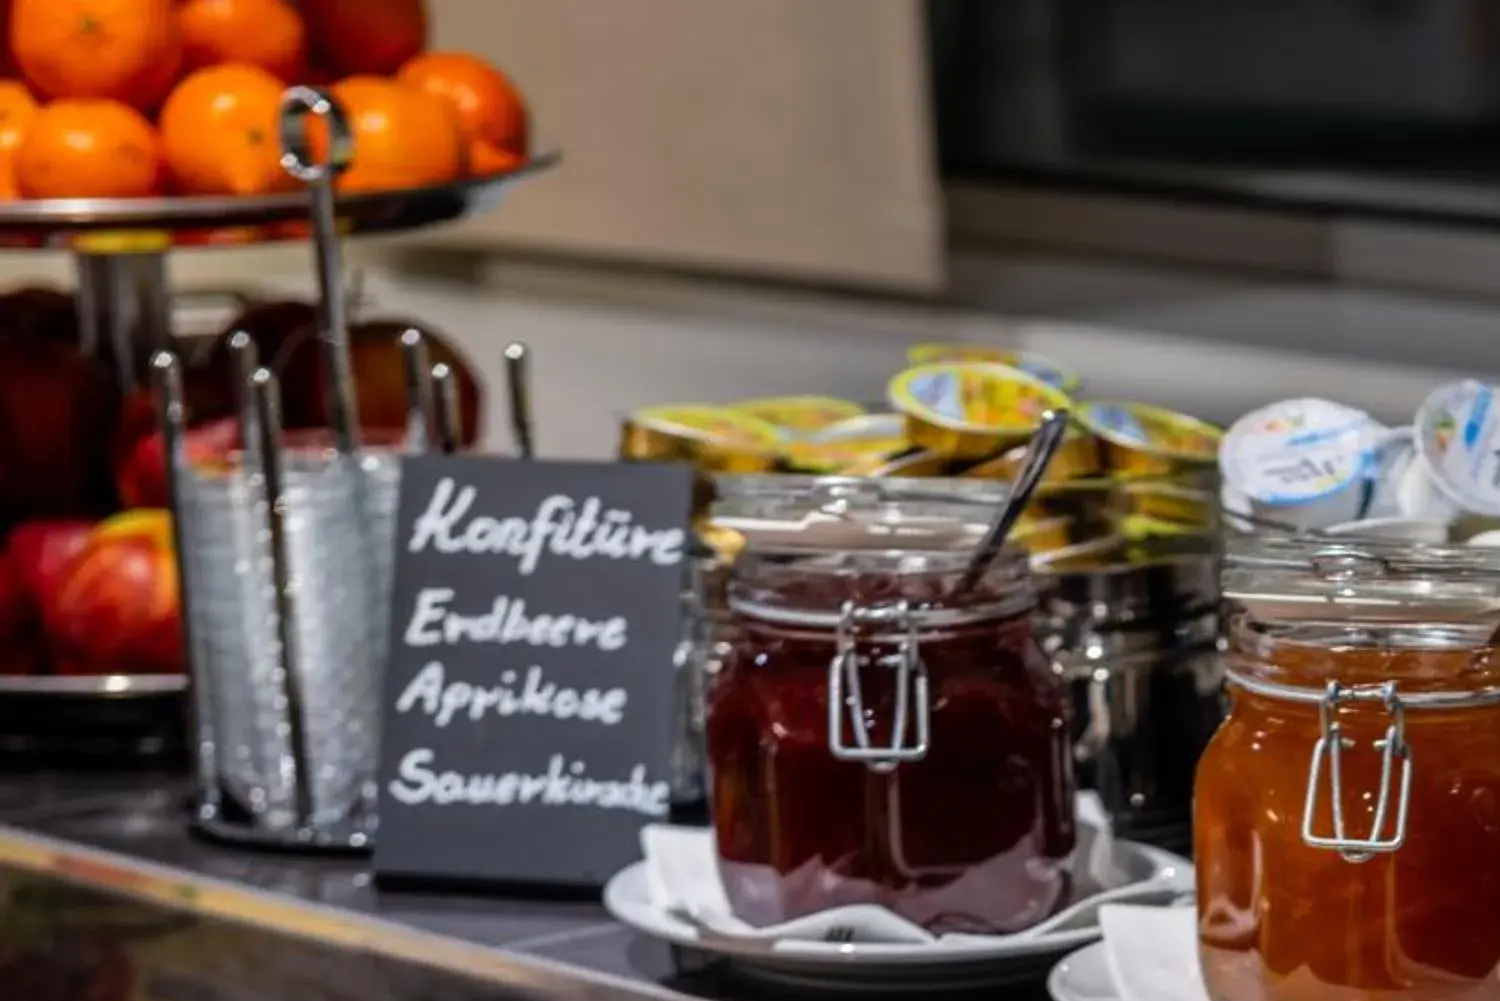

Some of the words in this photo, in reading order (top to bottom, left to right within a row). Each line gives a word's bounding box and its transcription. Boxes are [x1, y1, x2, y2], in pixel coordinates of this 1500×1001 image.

[408, 476, 686, 576] Konfitüre
[403, 586, 628, 652] Erdbeere
[395, 660, 629, 728] Aprikose
